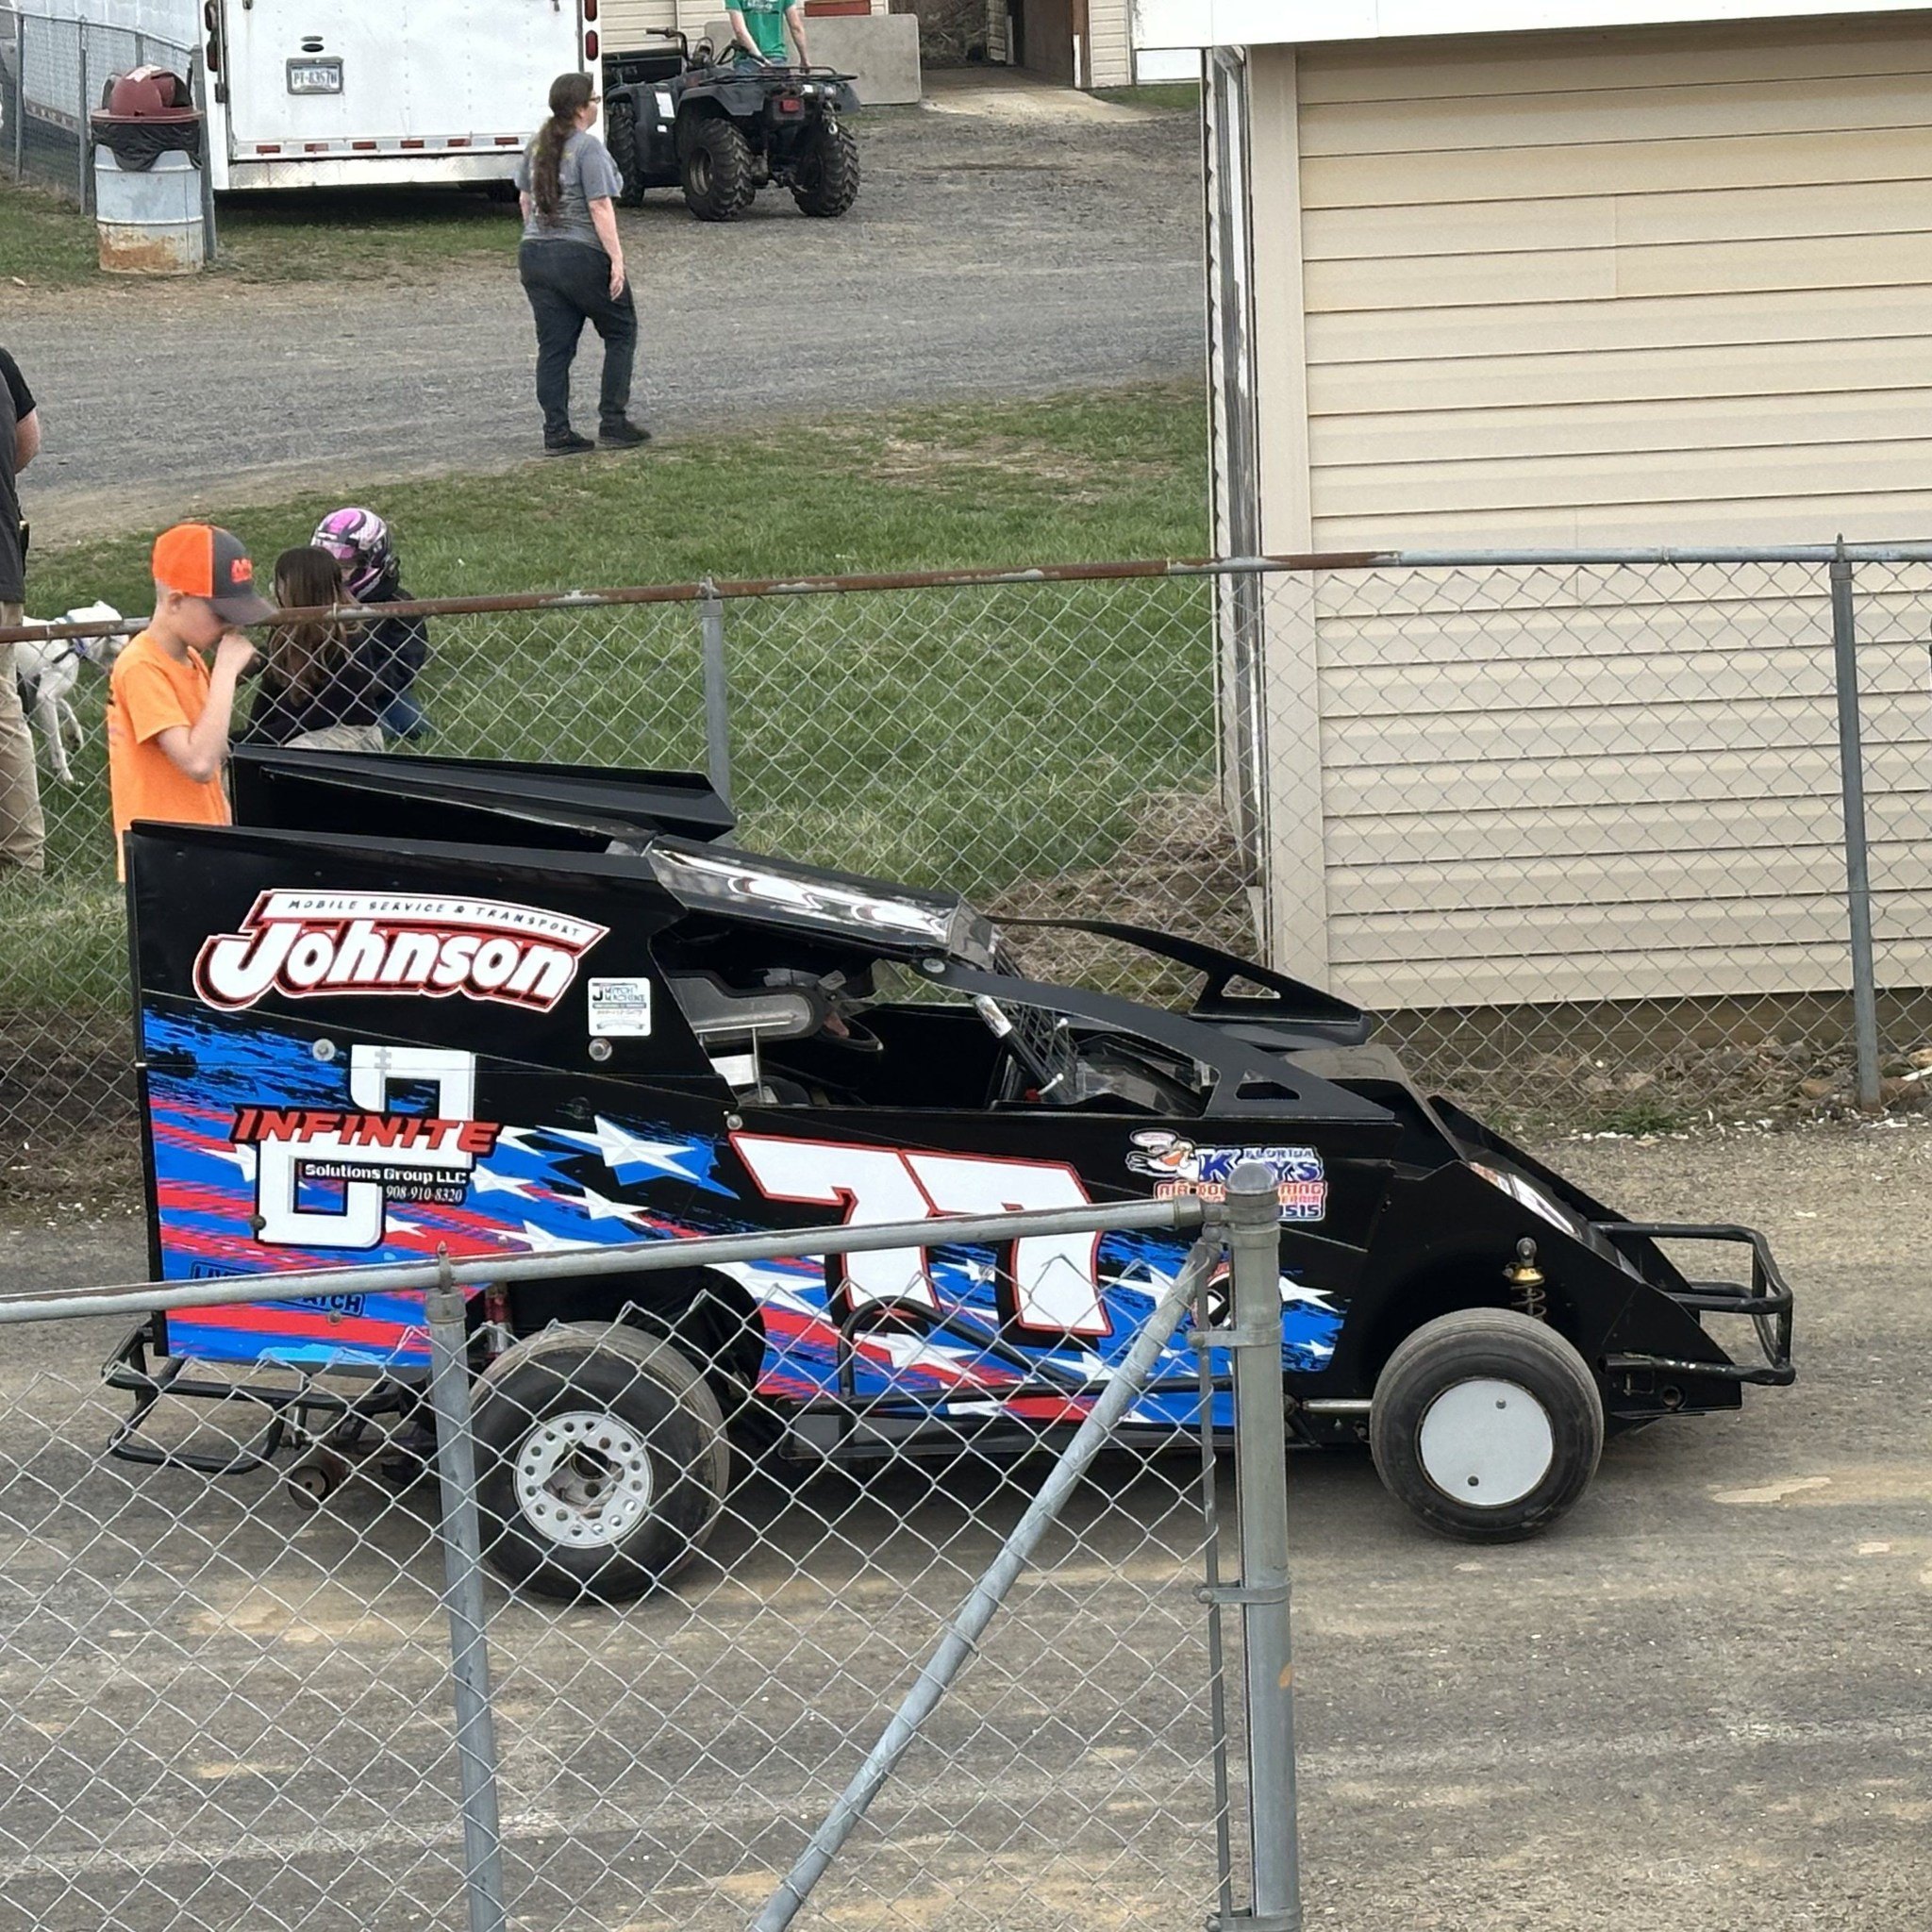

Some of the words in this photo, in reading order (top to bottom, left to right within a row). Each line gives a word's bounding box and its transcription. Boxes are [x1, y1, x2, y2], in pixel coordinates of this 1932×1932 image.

[288, 899, 358, 910] MOBILE
[369, 901, 445, 913] SERVICE
[454, 905, 465, 914] &
[475, 907, 580, 937] TRANSPORT
[207, 918, 577, 1001] Johnson
[234, 1108, 502, 1154] INFINITE
[1197, 1149, 1319, 1182] KYS
[1245, 1148, 1313, 1159] FLORIDA
[304, 1163, 381, 1180] Solutions
[383, 1167, 434, 1185] Group
[436, 1171, 467, 1185] LLC
[386, 1184, 464, 1204] 908-910-8320
[728, 1132, 1113, 1336] 77
